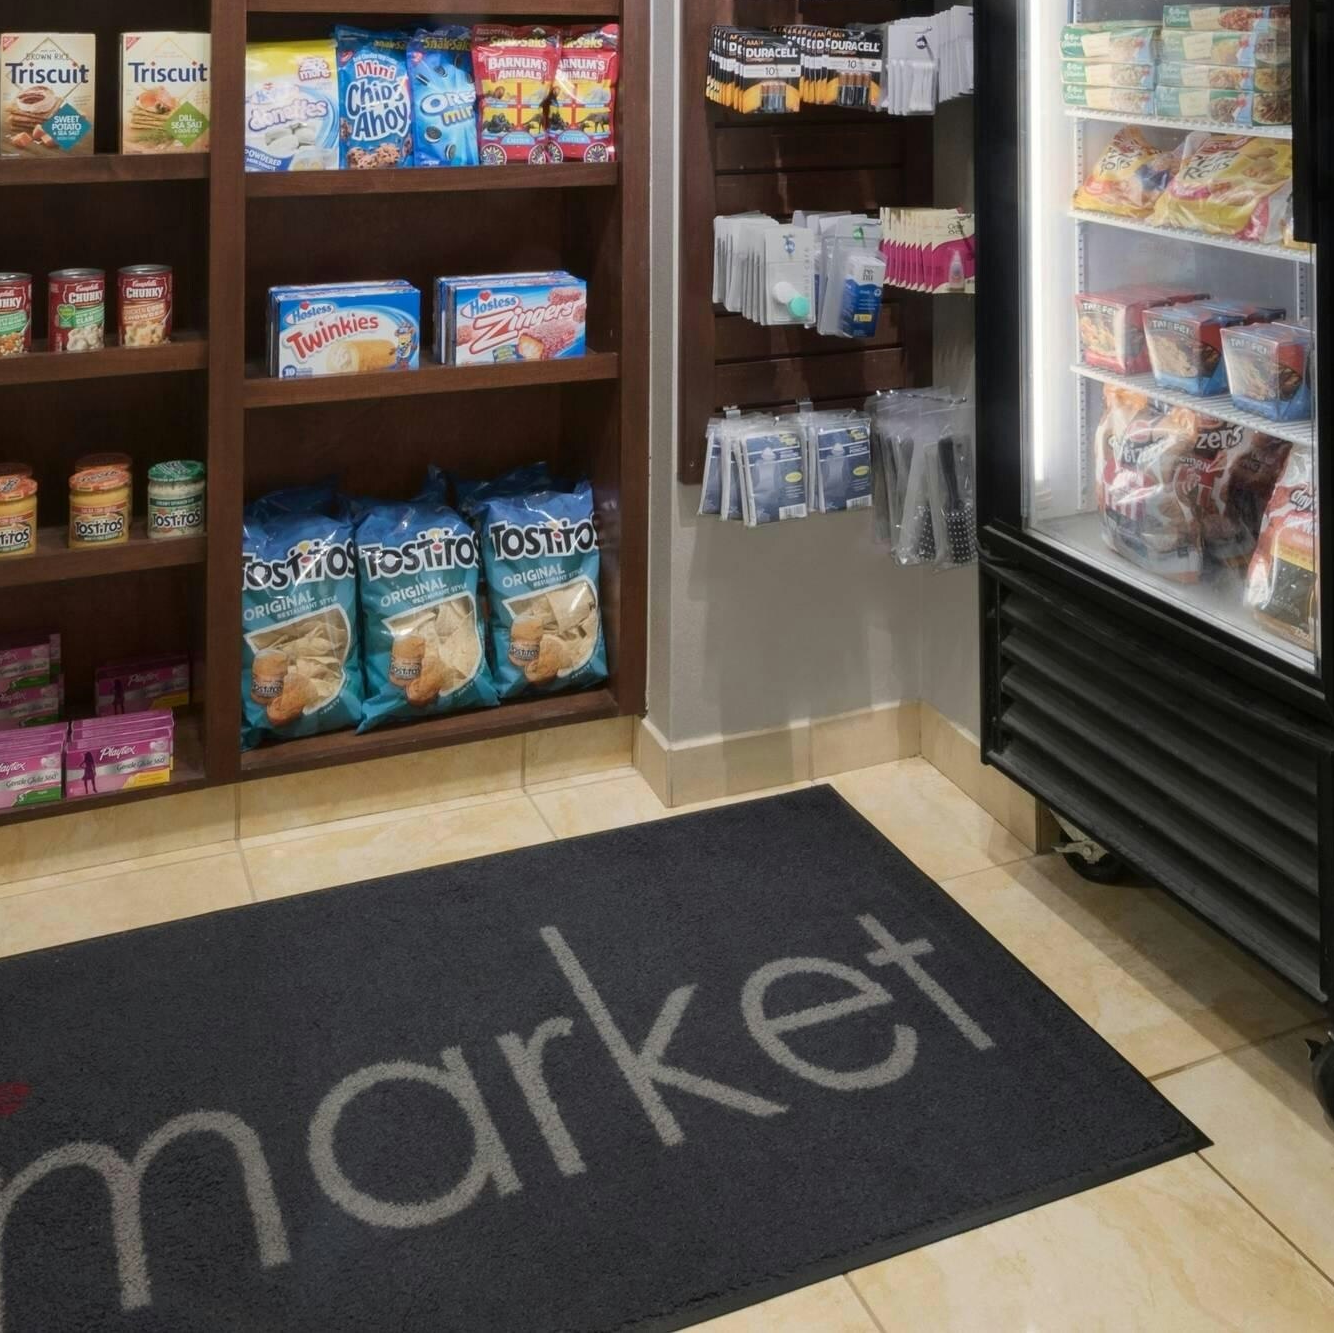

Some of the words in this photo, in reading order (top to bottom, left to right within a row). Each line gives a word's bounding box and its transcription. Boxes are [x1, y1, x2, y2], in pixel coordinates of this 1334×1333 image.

[745, 47, 799, 58] DURACELL
[831, 40, 880, 53] DURACELL
[5, 62, 90, 85] Triscuit
[128, 62, 208, 83] Triscuit
[356, 61, 396, 80] Mini
[488, 57, 548, 71] BARNUM'S
[498, 70, 543, 81] ANIMALS
[348, 81, 404, 116] Chips
[51, 123, 82, 132] POTATO
[354, 106, 410, 139] Ahoy
[126, 286, 164, 299] CHUNKY
[290, 303, 334, 323] Hostess
[469, 295, 517, 317] Hostess
[285, 315, 380, 360] Twinkies
[469, 304, 575, 355] Zingers
[76, 516, 123, 536] TOSTITOS
[152, 510, 201, 528] TOSTITOS
[502, 564, 565, 588] ORIGINAL
[380, 577, 446, 607] ORIGINAL
[244, 592, 315, 621] ORIGINAL
[100, 745, 136, 761] Playtex
